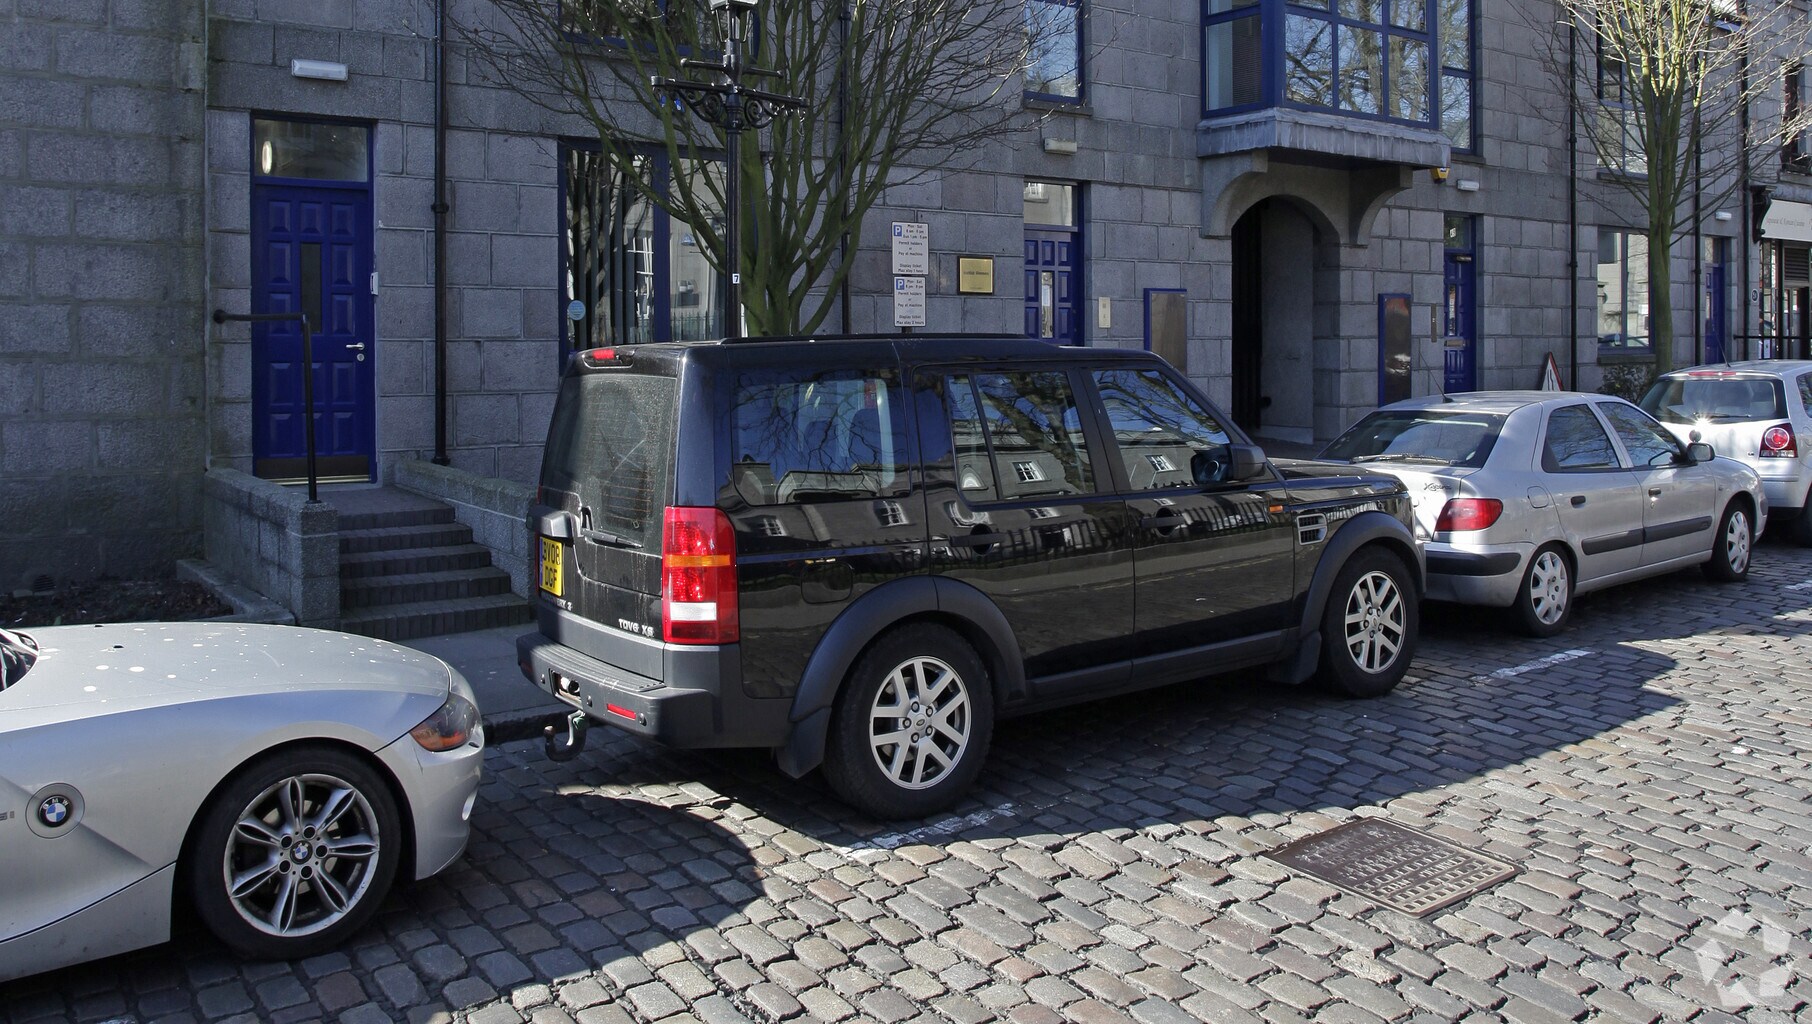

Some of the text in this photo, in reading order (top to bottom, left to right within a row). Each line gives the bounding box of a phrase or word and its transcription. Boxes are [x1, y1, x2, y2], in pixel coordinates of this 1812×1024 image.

[895, 226, 901, 236] P
[898, 279, 904, 289] P
[43, 798, 69, 810] BMW
